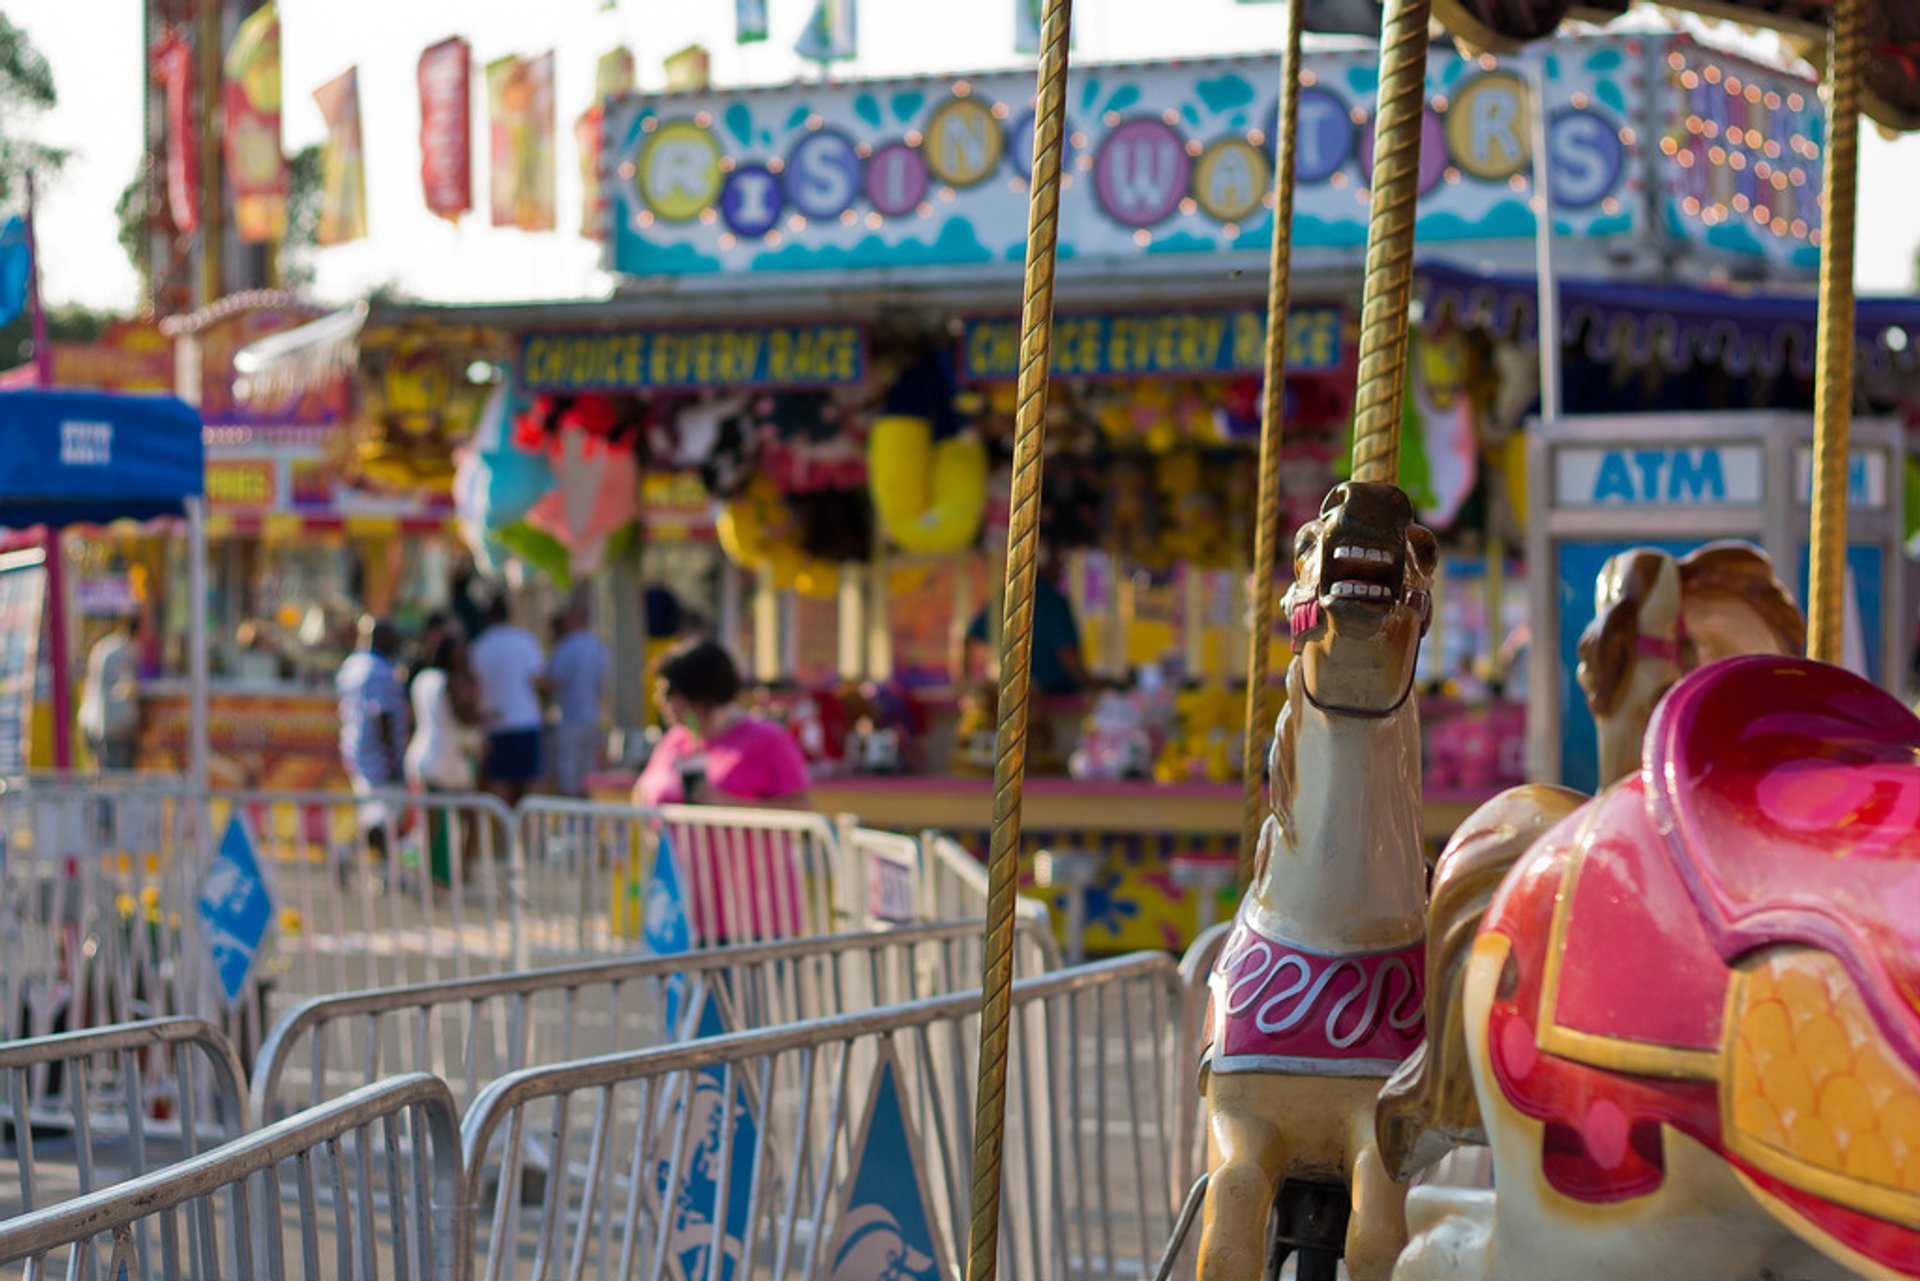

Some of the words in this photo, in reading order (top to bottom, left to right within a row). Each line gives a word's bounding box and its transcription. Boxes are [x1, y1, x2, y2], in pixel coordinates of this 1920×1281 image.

[645, 104, 1052, 225] RISIN
[1109, 88, 1611, 211] WATRS
[647, 331, 763, 383] EVERY
[767, 327, 860, 380] RACE
[1108, 315, 1227, 370] EVERY
[1232, 311, 1337, 366] RCE
[1593, 449, 1727, 502] ATM
